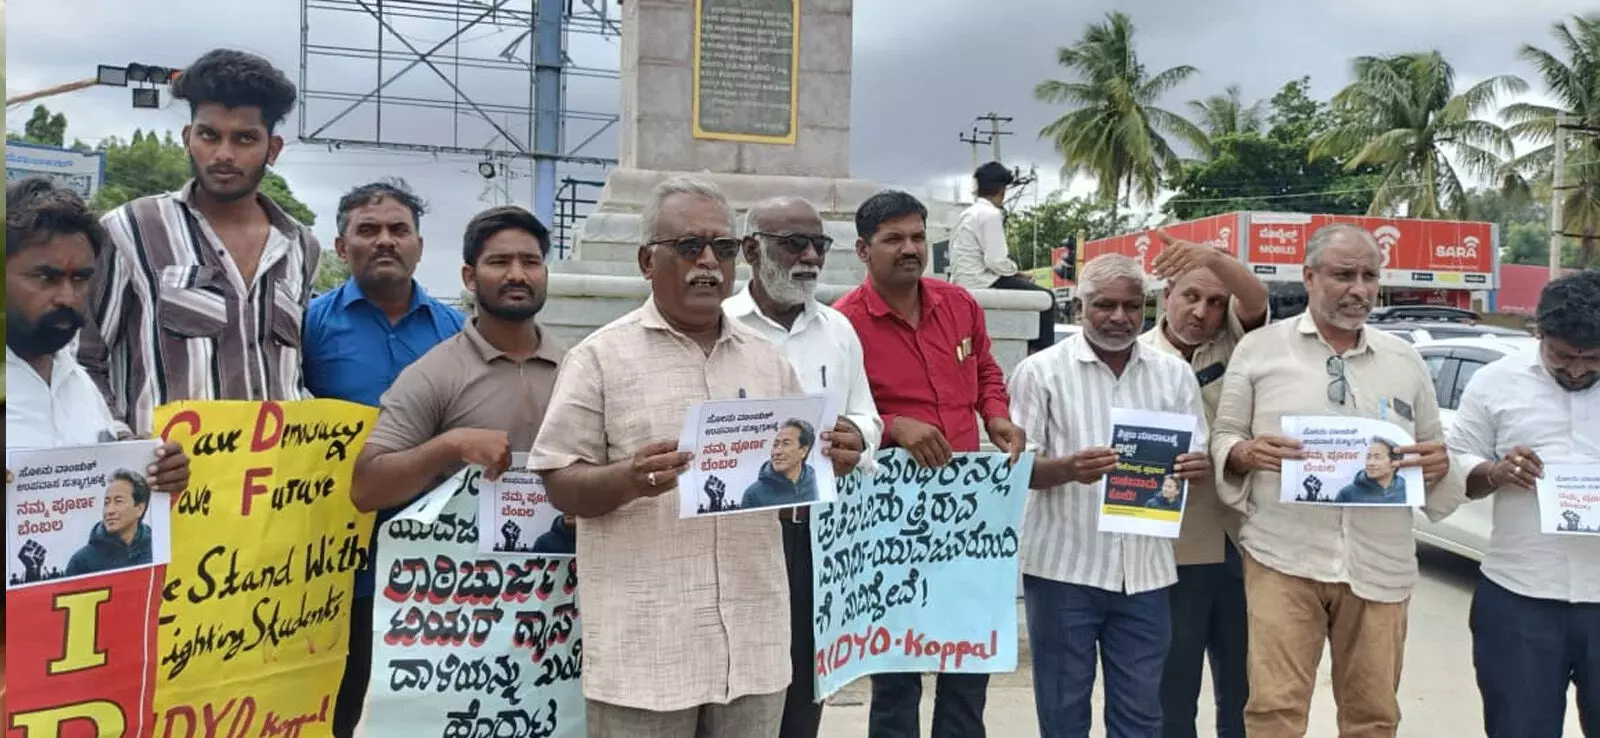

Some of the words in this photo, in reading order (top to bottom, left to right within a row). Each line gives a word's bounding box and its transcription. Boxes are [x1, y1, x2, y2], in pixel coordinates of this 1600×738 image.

[1435, 245, 1477, 259] SARA
[703, 442, 728, 456] ನಮ್ಮ
[730, 439, 768, 454] ಪೂರ್ಣ
[701, 458, 737, 472] ಬೆಂಬಲ
[170, 485, 212, 516] ave
[501, 491, 526, 505] ನಮ್ಮ
[17, 499, 50, 518] ನಮ್ಮ
[52, 496, 97, 515] ಪೂರ್ಣ
[501, 504, 535, 517] ಬೆಂಬಲ
[18, 519, 64, 536] ಬೆಂಬಲ
[188, 545, 294, 604] Stand
[305, 532, 370, 582] With
[46, 587, 111, 676] I
[159, 614, 246, 680] ighting
[244, 585, 345, 651] Students
